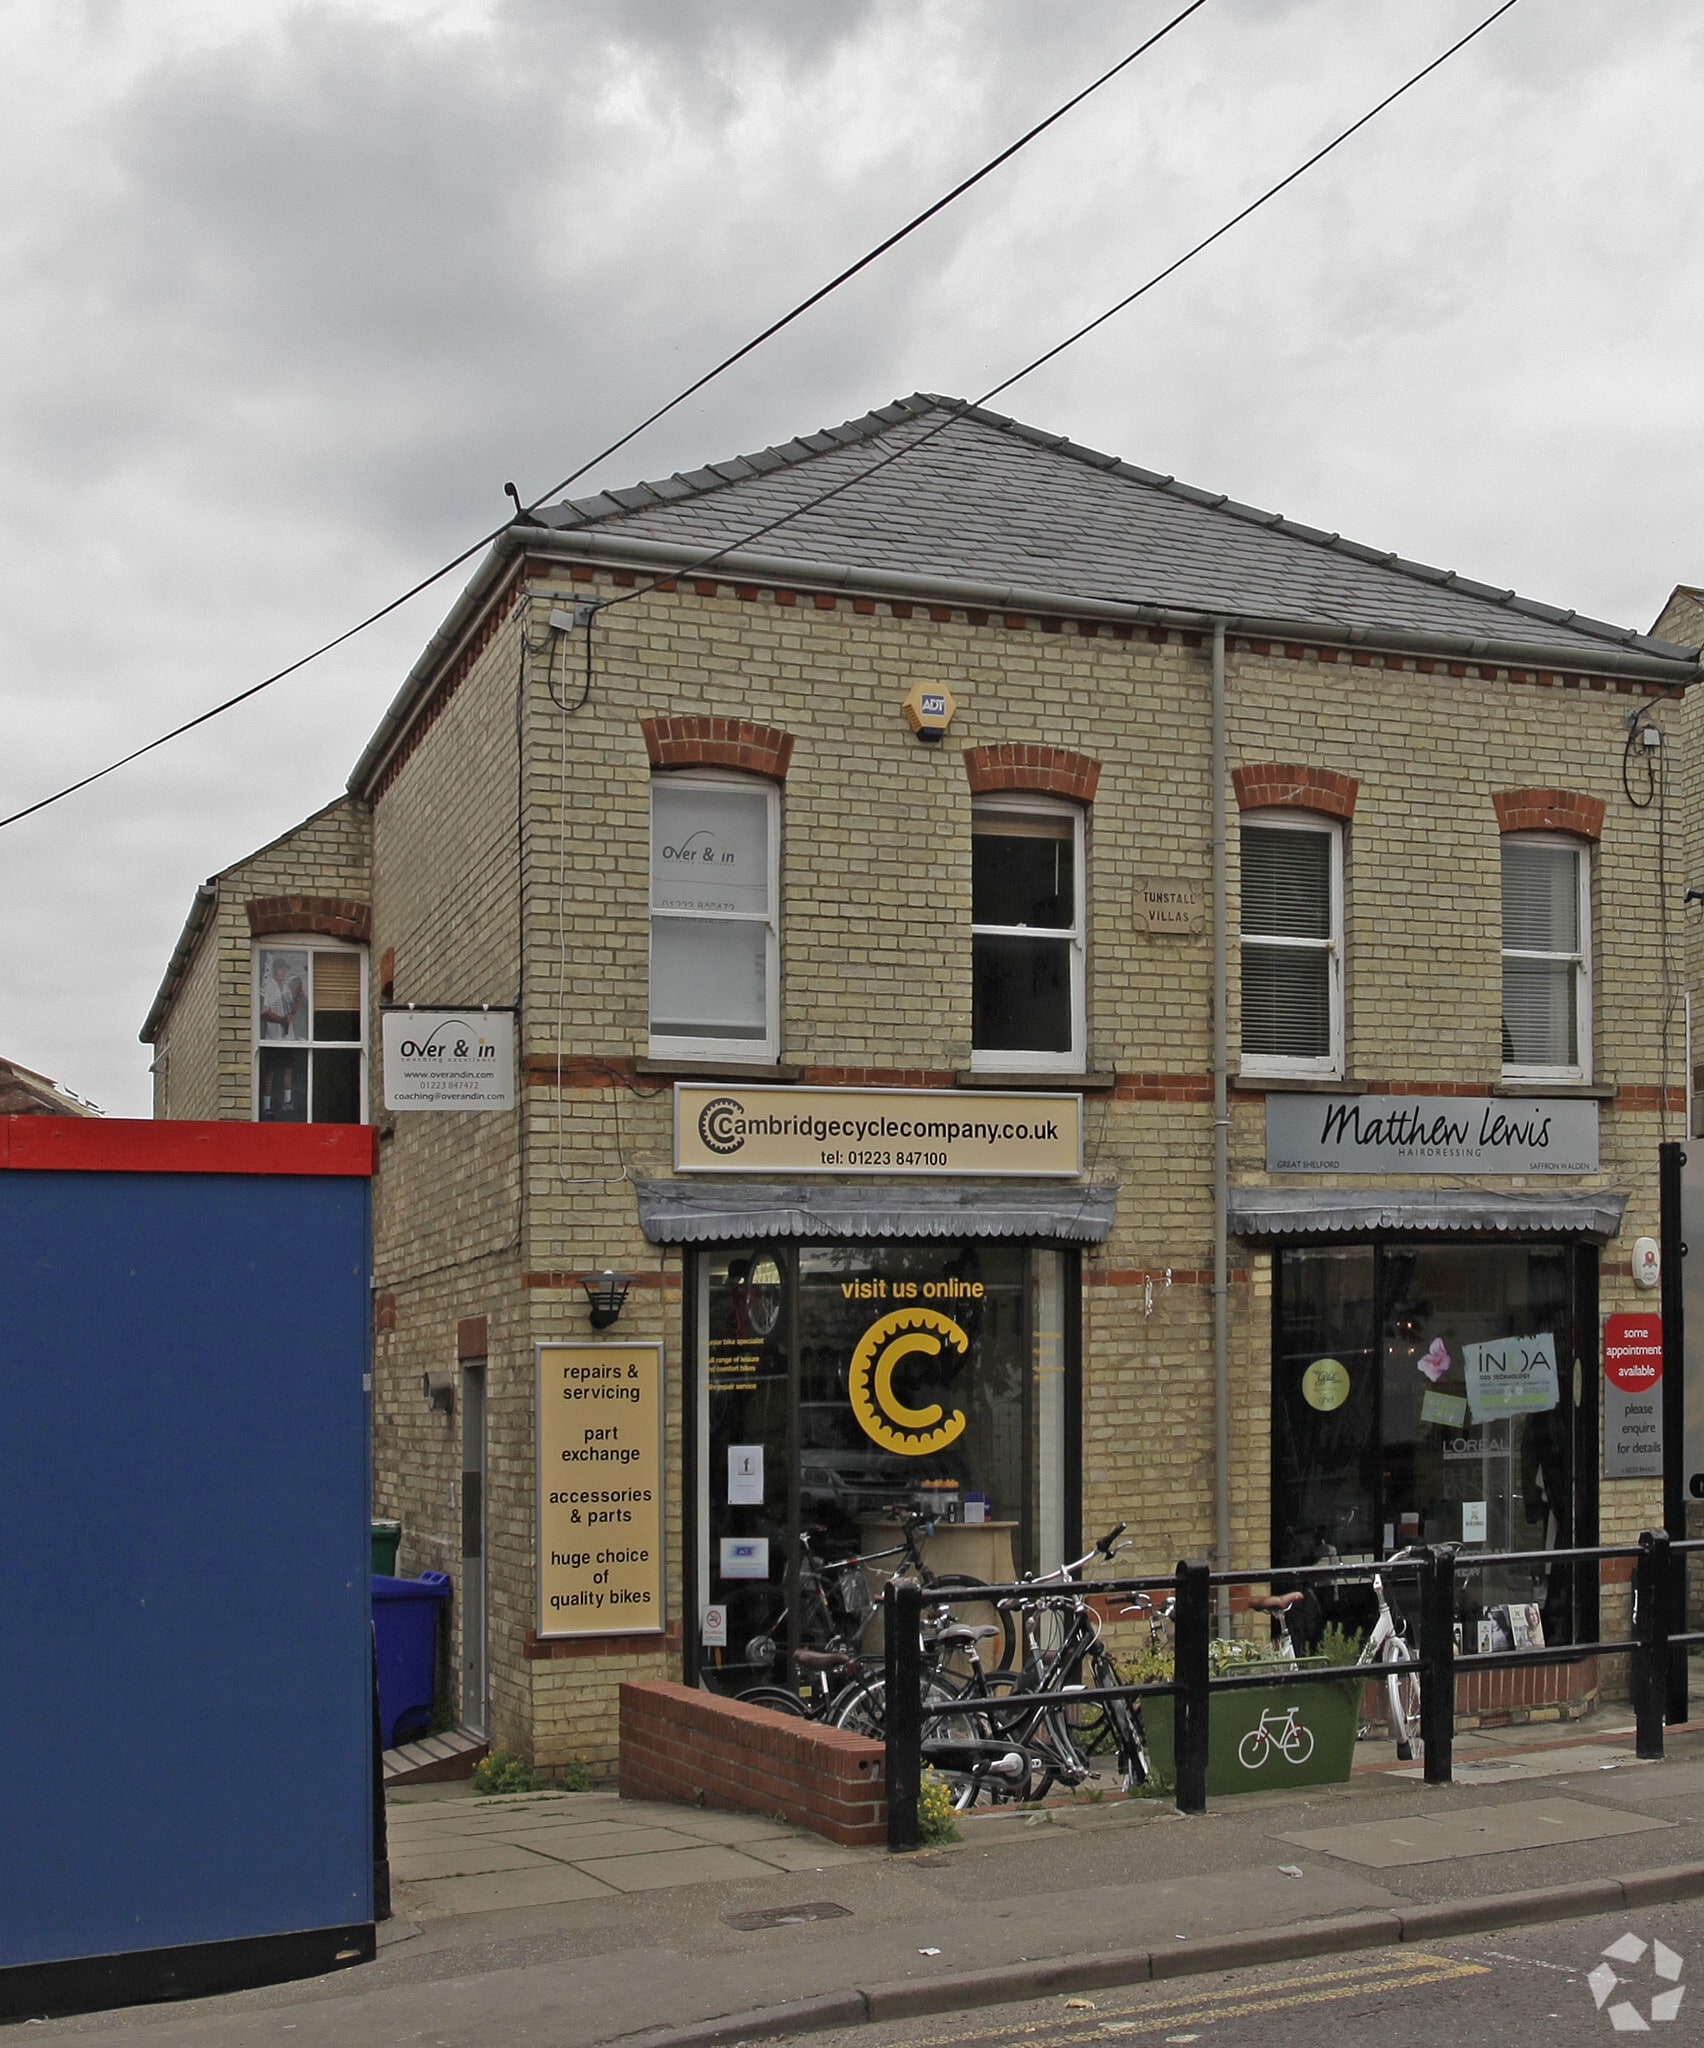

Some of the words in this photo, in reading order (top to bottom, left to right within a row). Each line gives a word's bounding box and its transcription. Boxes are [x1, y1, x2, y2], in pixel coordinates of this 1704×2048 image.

[922, 698, 945, 711] ADT
[662, 845, 697, 861] Over
[702, 846, 715, 862] &
[721, 847, 735, 863] in
[1143, 891, 1196, 905] TUNSTALL
[1148, 910, 1190, 922] VILLAS
[400, 1040, 446, 1058] Over
[453, 1039, 470, 1058] &
[478, 1037, 496, 1058] in
[403, 1071, 495, 1079] www.overandin.com
[420, 1081, 446, 1089] 01223
[449, 1081, 480, 1089] 847472
[1320, 1103, 1469, 1146] Matthew
[820, 1150, 844, 1165] tel:
[848, 1151, 891, 1165] 01223
[896, 1152, 948, 1166] 847100
[1398, 1147, 1482, 1158] HAIRDRESSING
[1277, 1160, 1301, 1169] GREAT
[1303, 1160, 1340, 1169] SHELFORD
[1529, 1162, 1559, 1170] SAFFRON
[1560, 1162, 1590, 1170] WALDEN
[841, 1278, 886, 1298] visit
[892, 1282, 917, 1298] us
[923, 1278, 984, 1298] online
[1623, 1329, 1649, 1338] some
[563, 1364, 621, 1382] repairs
[627, 1364, 639, 1378] &
[1618, 1365, 1656, 1377] available
[563, 1385, 640, 1402] servicing
[1624, 1403, 1654, 1417] please
[584, 1426, 618, 1444] part
[1621, 1424, 1656, 1436] enquire
[1617, 1443, 1631, 1454] for
[1632, 1441, 1661, 1454] details
[562, 1447, 640, 1464] exchange
[549, 1487, 652, 1503] accessories
[570, 1509, 582, 1523] &
[588, 1508, 632, 1526] parts
[551, 1551, 590, 1568] huge
[596, 1548, 649, 1563] choice
[593, 1569, 609, 1584] of
[550, 1590, 604, 1610] quality
[610, 1589, 651, 1604] bikes
